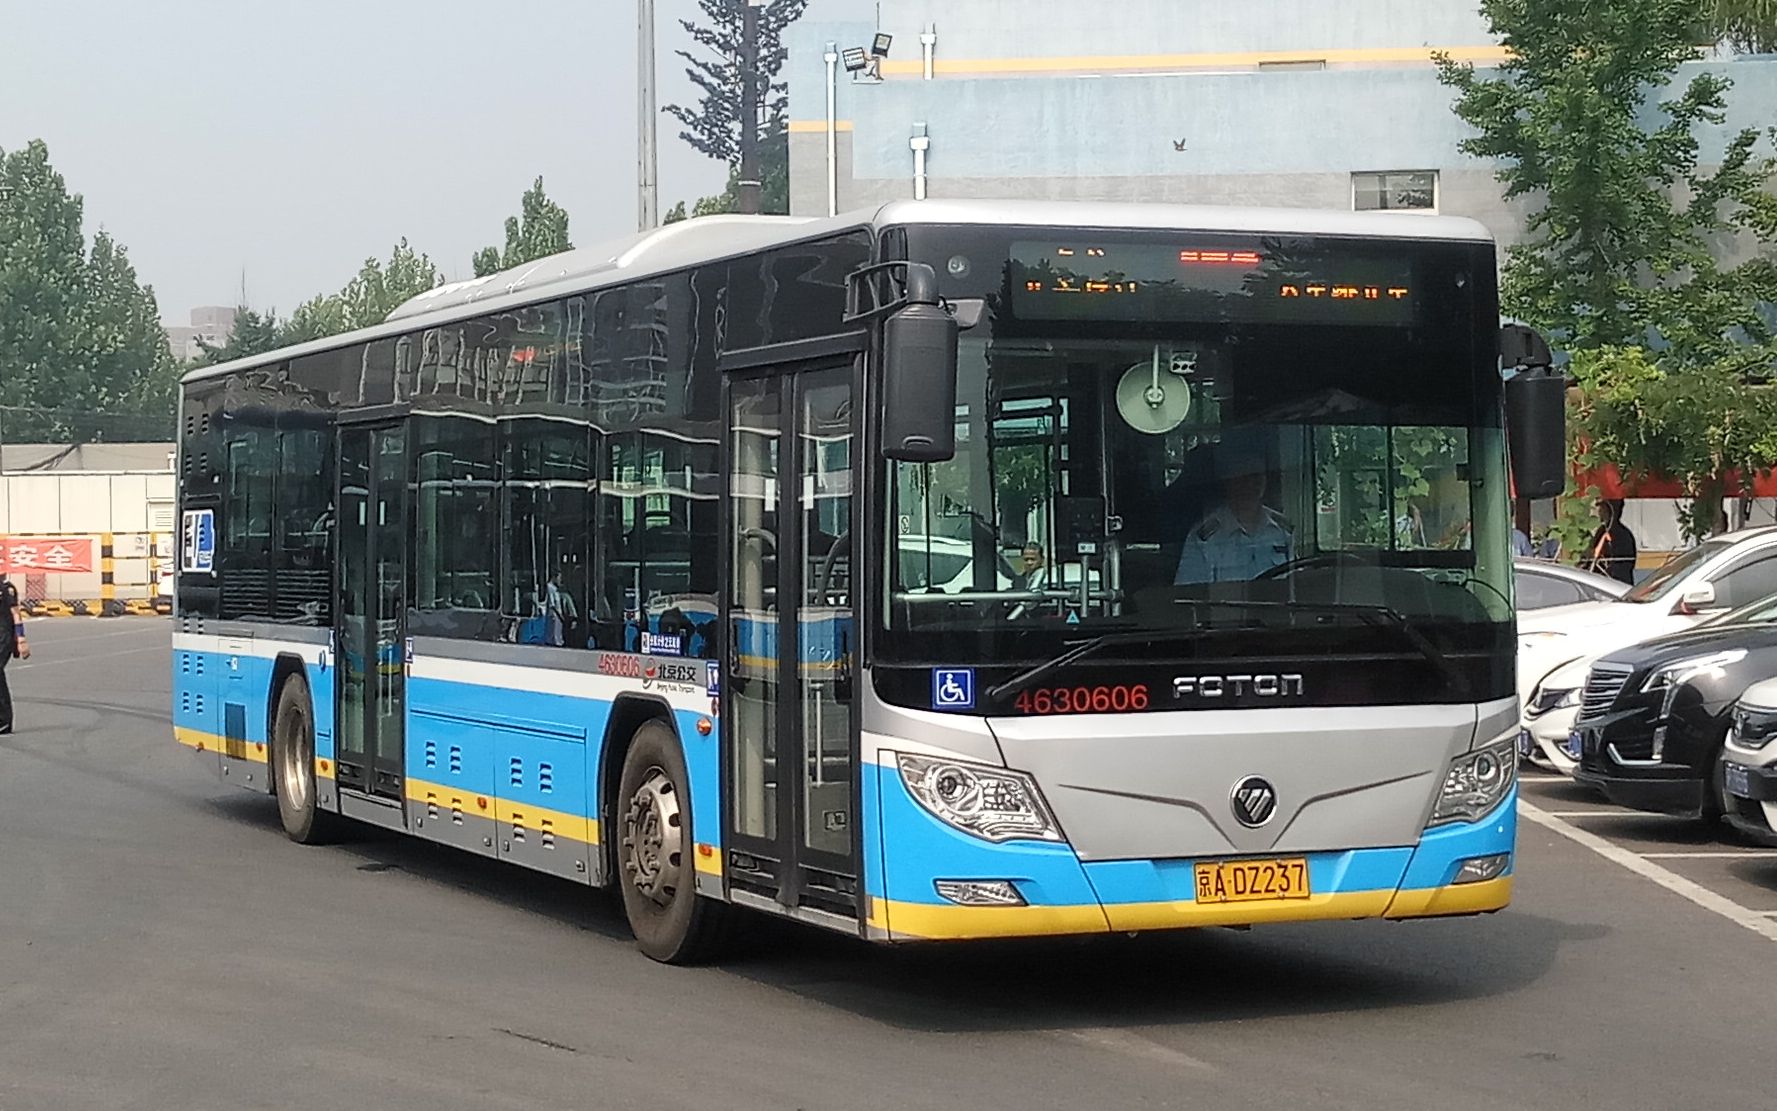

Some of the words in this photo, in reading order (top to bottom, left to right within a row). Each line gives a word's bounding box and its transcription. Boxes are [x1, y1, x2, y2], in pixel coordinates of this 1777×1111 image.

[0, 544, 73, 569] 安全
[658, 664, 696, 681] 北京公交
[1014, 685, 1149, 713] 4630606
[1173, 674, 1304, 699] FOTON
